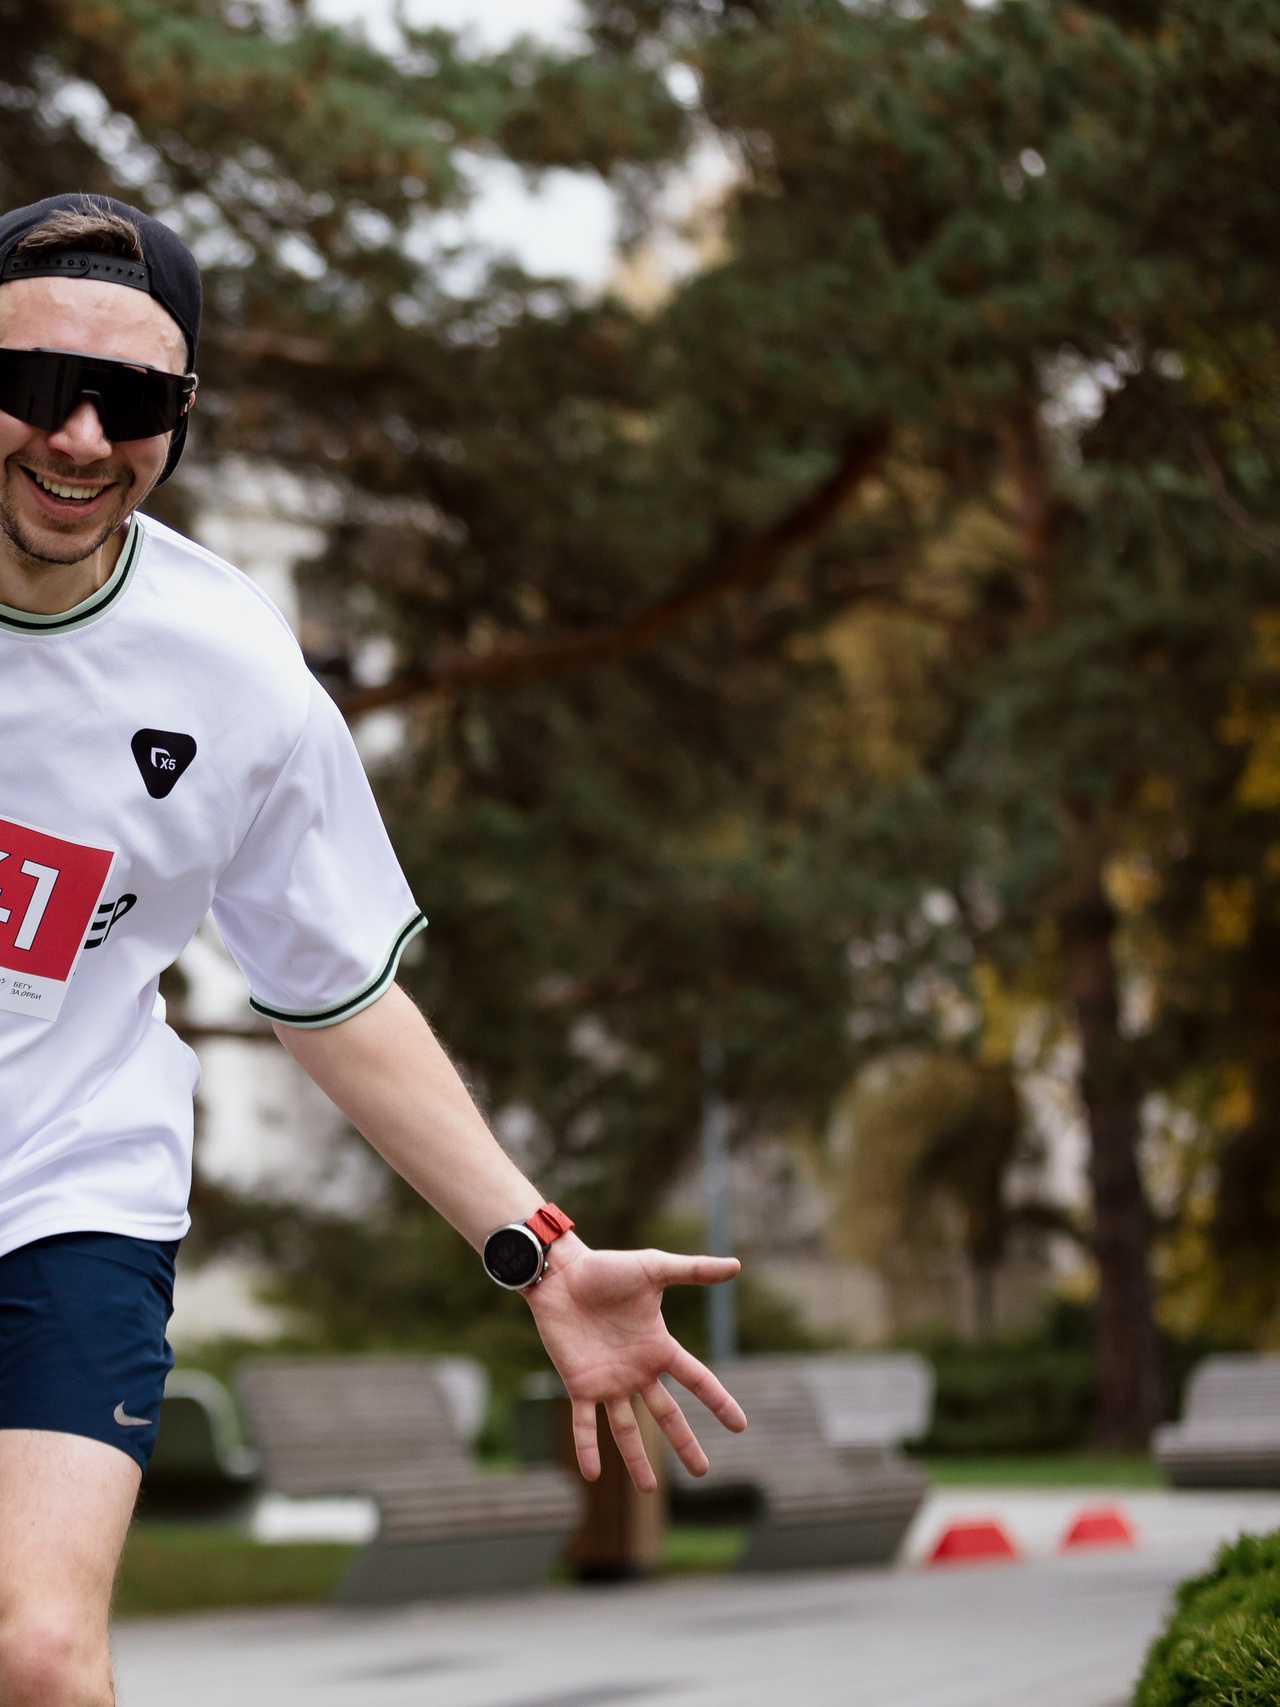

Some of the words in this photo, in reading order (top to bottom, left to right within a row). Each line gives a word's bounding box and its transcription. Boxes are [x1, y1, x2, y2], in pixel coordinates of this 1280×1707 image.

[159, 757, 177, 771] X5
[12, 981, 33, 991] БЕГУ
[10, 988, 20, 997] ЗА
[19, 990, 42, 1001] ОРБИ
